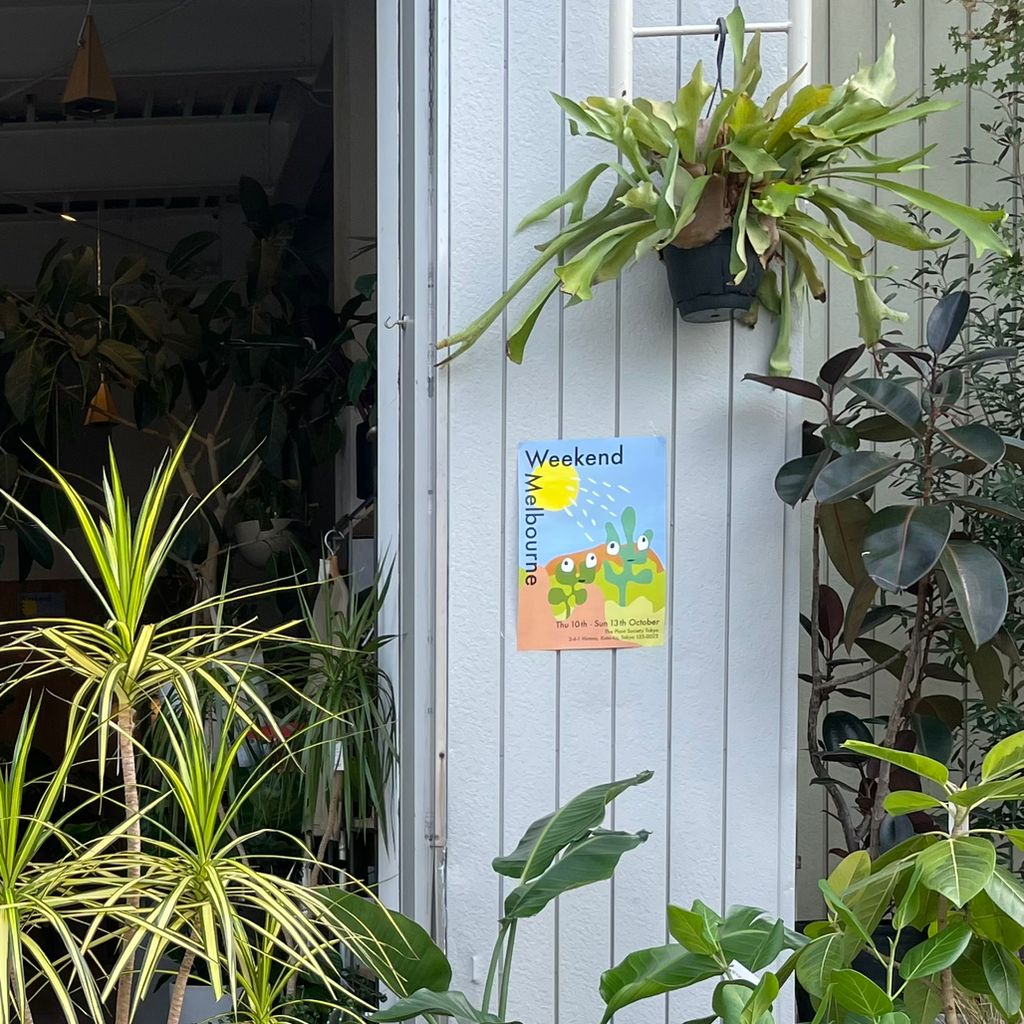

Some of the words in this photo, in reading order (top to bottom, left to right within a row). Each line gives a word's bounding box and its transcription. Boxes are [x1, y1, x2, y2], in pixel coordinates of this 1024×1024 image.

[525, 444, 624, 469] Weekend
[525, 473, 545, 586] Melbourne
[556, 620, 569, 629] Thu
[571, 619, 588, 628] 10th
[594, 619, 608, 627] Sun
[610, 618, 626, 626] 13th
[629, 618, 660, 626] October
